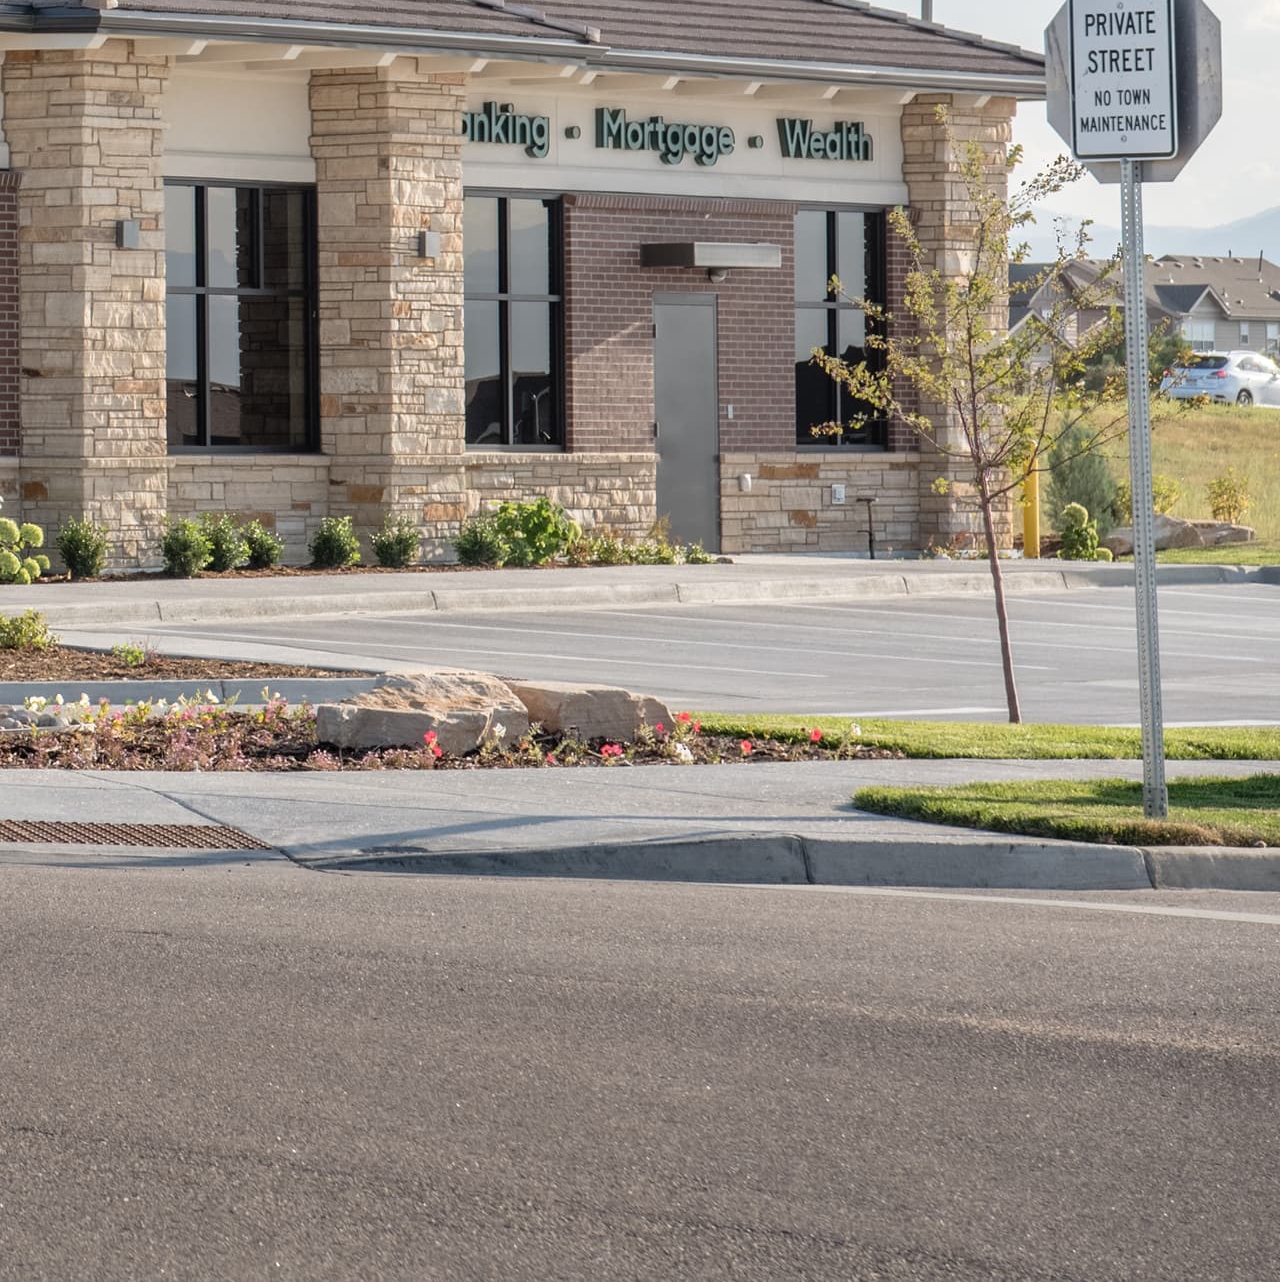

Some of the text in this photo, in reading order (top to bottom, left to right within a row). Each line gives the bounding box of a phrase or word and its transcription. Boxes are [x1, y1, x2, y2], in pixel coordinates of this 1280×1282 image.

[1085, 11, 1156, 36] PRIVATE
[1088, 48, 1155, 73] STREET
[1094, 89, 1150, 106] NO TOWN
[1081, 114, 1166, 132] MAINTENANCE
[595, 107, 736, 166] Mortgage
[776, 118, 874, 161] Wealth
